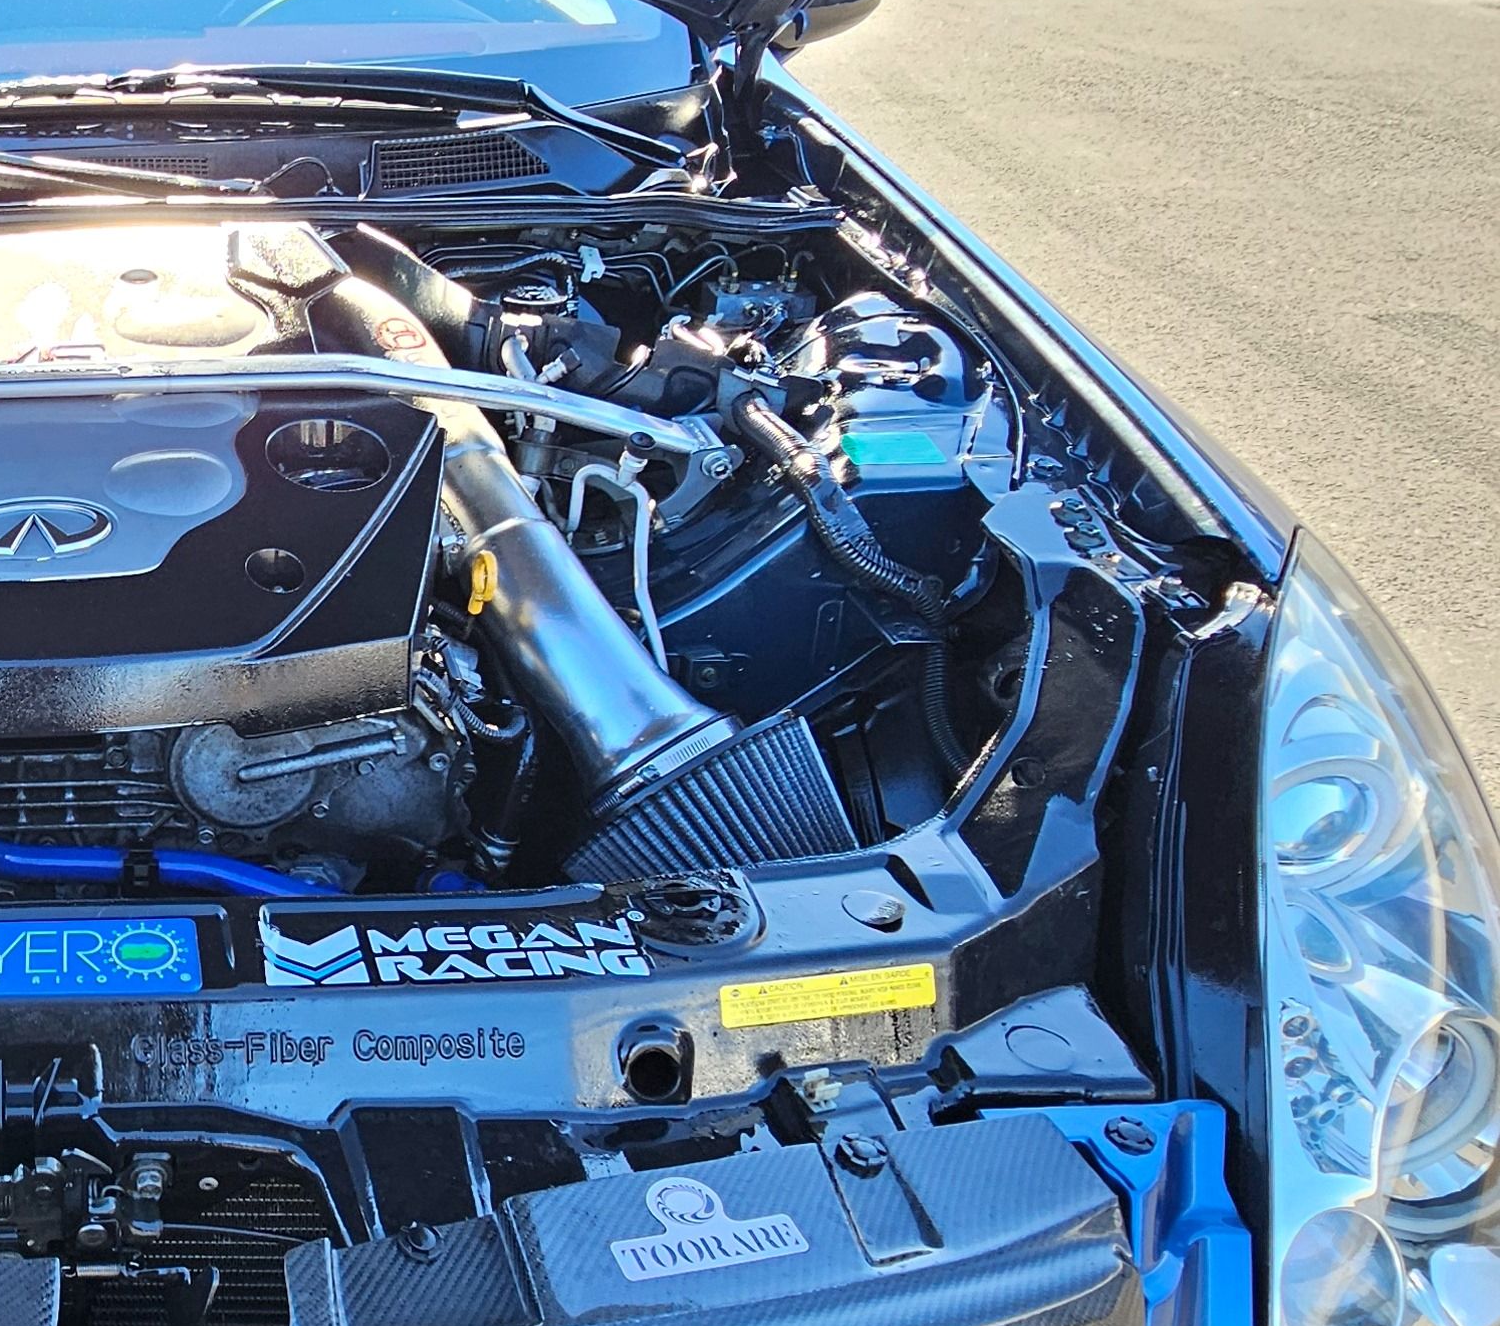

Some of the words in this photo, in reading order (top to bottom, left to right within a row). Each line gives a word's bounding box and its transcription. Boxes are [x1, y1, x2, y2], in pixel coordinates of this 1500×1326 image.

[366, 918, 636, 954] MEGAN
[31, 974, 107, 985] RICO
[375, 948, 650, 981] RACING
[768, 982, 804, 993] CAUTION
[132, 1031, 333, 1066] Glass-Fiber
[353, 1027, 526, 1066] Composite
[621, 1222, 799, 1271] TOORARE
